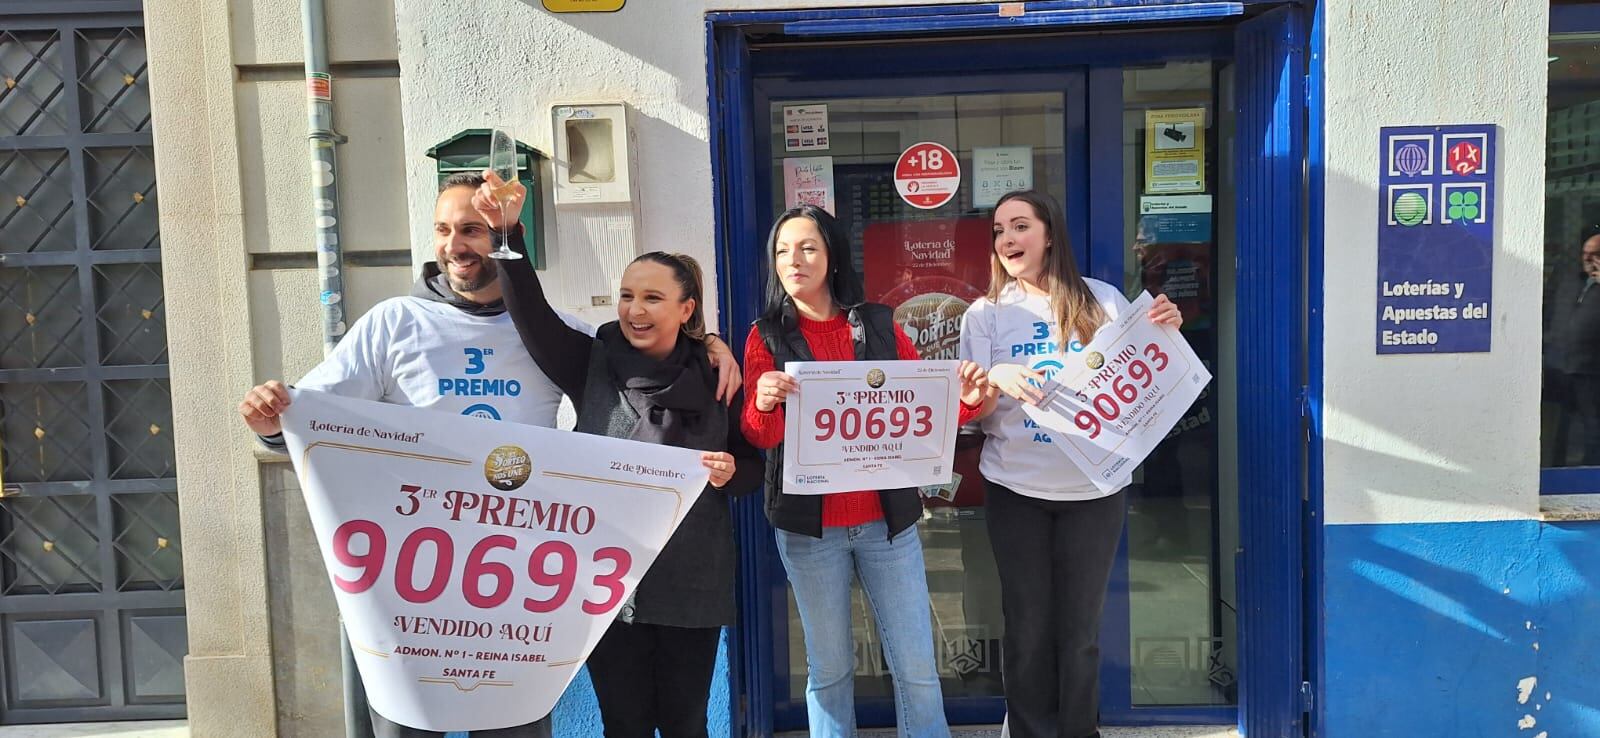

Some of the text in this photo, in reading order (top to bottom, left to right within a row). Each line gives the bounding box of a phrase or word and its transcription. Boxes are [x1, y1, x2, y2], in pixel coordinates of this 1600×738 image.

[907, 149, 944, 171] +18
[943, 240, 956, 250] de
[911, 250, 951, 260] Navidad
[1382, 279, 1465, 299] Loterías y
[1382, 303, 1488, 324] Apuestas del
[1382, 329, 1438, 346] Estado
[1088, 344, 1137, 389] PREMIO
[438, 378, 522, 397] PREMIO
[853, 389, 915, 405] PREMIO
[1074, 342, 1169, 440] 90693
[814, 405, 934, 442] 90693
[356, 427, 371, 437] de
[373, 428, 425, 444] Navidad
[841, 444, 880, 453] VENDIDO
[610, 461, 686, 480] 22 de Diciembre
[443, 490, 596, 535] PREMIO
[332, 519, 633, 616] 90693
[393, 615, 553, 645] VENDIDO AQUÍ
[393, 646, 442, 659] ADMON.
[475, 651, 509, 662] REINA
[510, 653, 547, 664] ISABEL
[442, 668, 496, 680] SANTA FE
